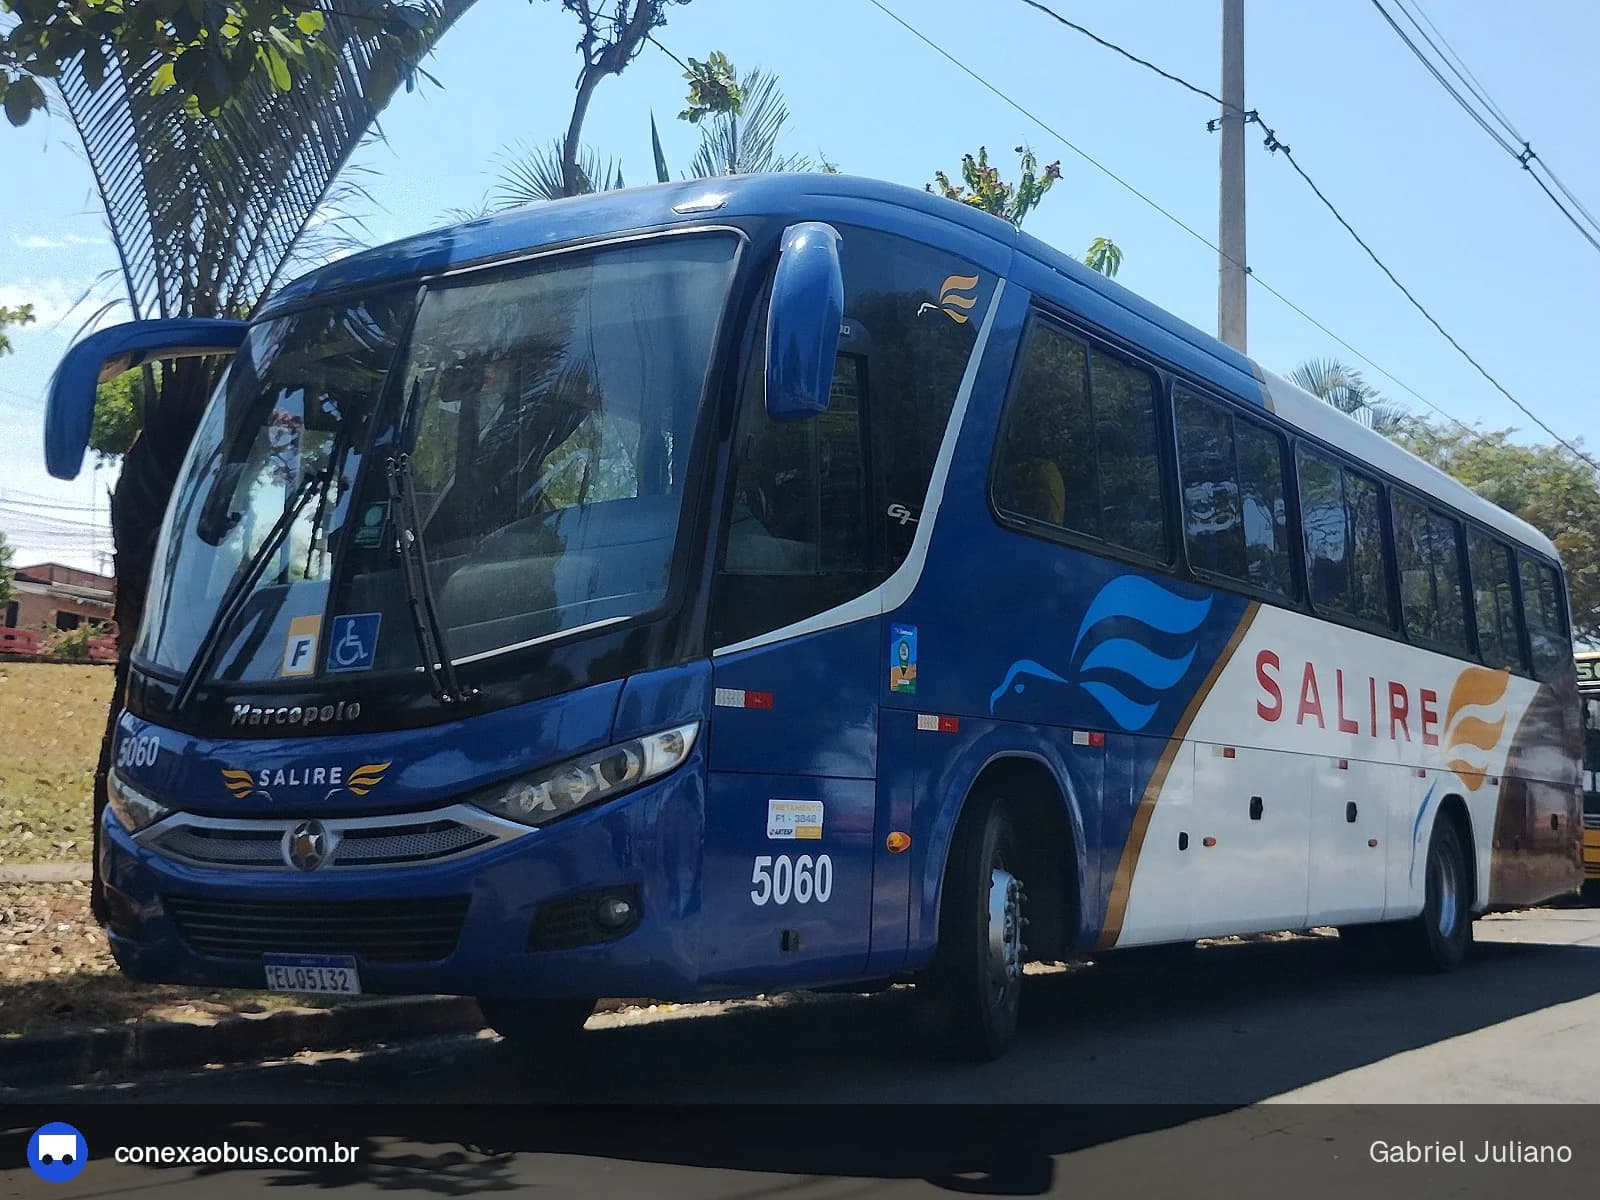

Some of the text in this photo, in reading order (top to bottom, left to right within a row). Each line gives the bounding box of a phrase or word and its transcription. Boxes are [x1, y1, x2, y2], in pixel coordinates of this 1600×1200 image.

[290, 640, 311, 668] F
[1255, 649, 1440, 746] SALIRE
[231, 700, 362, 727] Marcopolo
[116, 735, 160, 768] 5060
[259, 766, 343, 787] SALIRE
[750, 854, 833, 906] 5060
